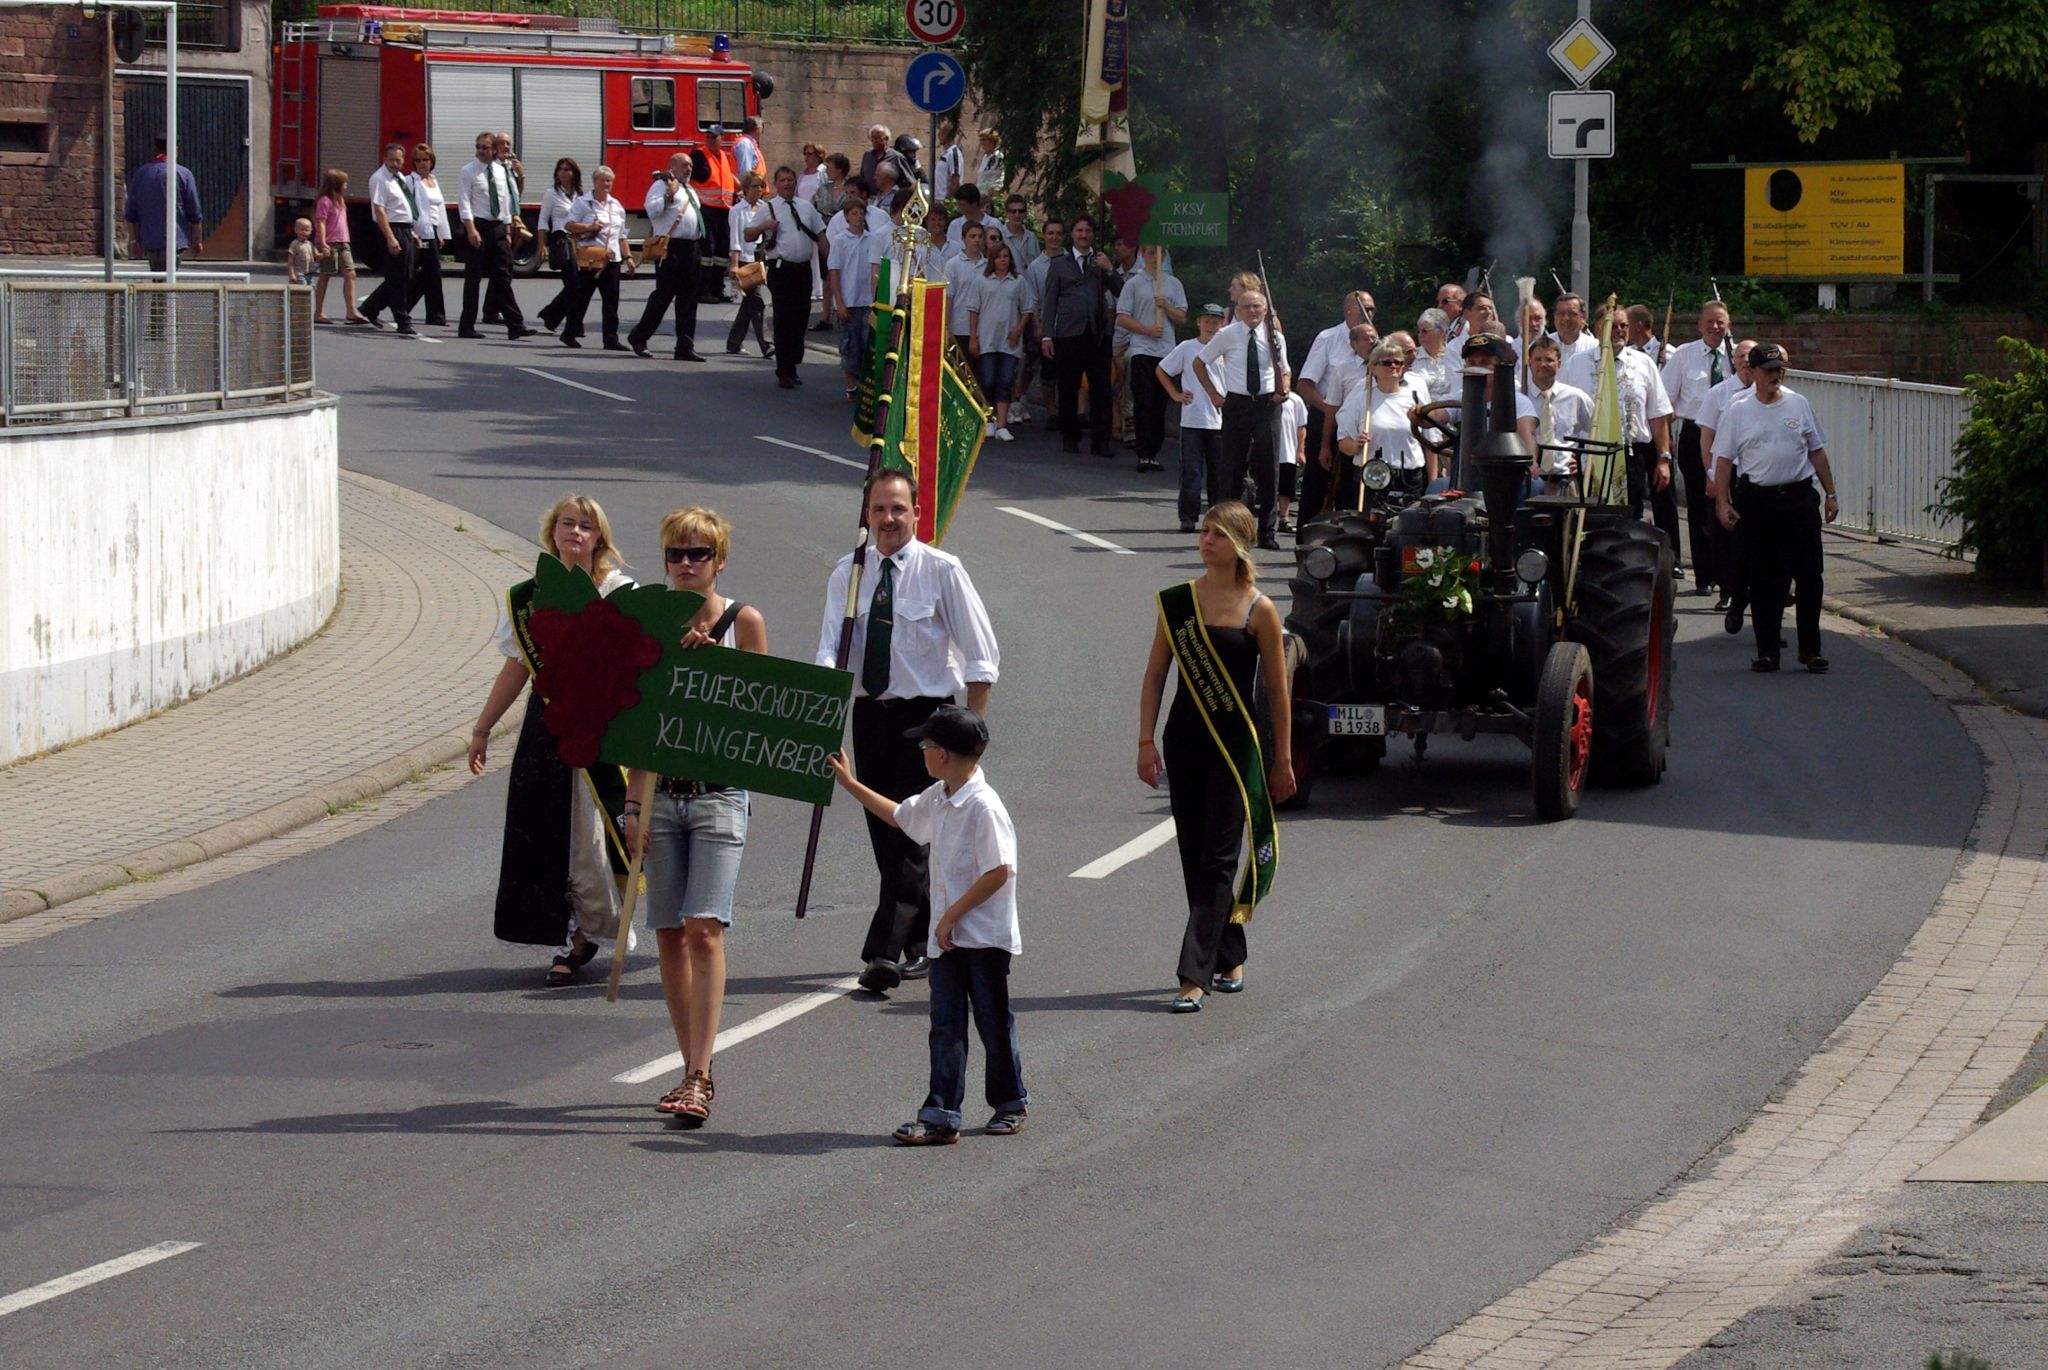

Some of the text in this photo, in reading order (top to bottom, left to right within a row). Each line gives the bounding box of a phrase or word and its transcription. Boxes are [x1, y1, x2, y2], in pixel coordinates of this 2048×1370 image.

[918, 1, 952, 26] 30
[1173, 202, 1205, 216] KKSV
[1160, 222, 1222, 236] TRENNFURT
[669, 665, 850, 730] FEUERSCHÜTZEN
[1338, 708, 1363, 720] MIL
[1335, 721, 1379, 734] B 1938
[655, 712, 840, 779] KLINGENBERG
